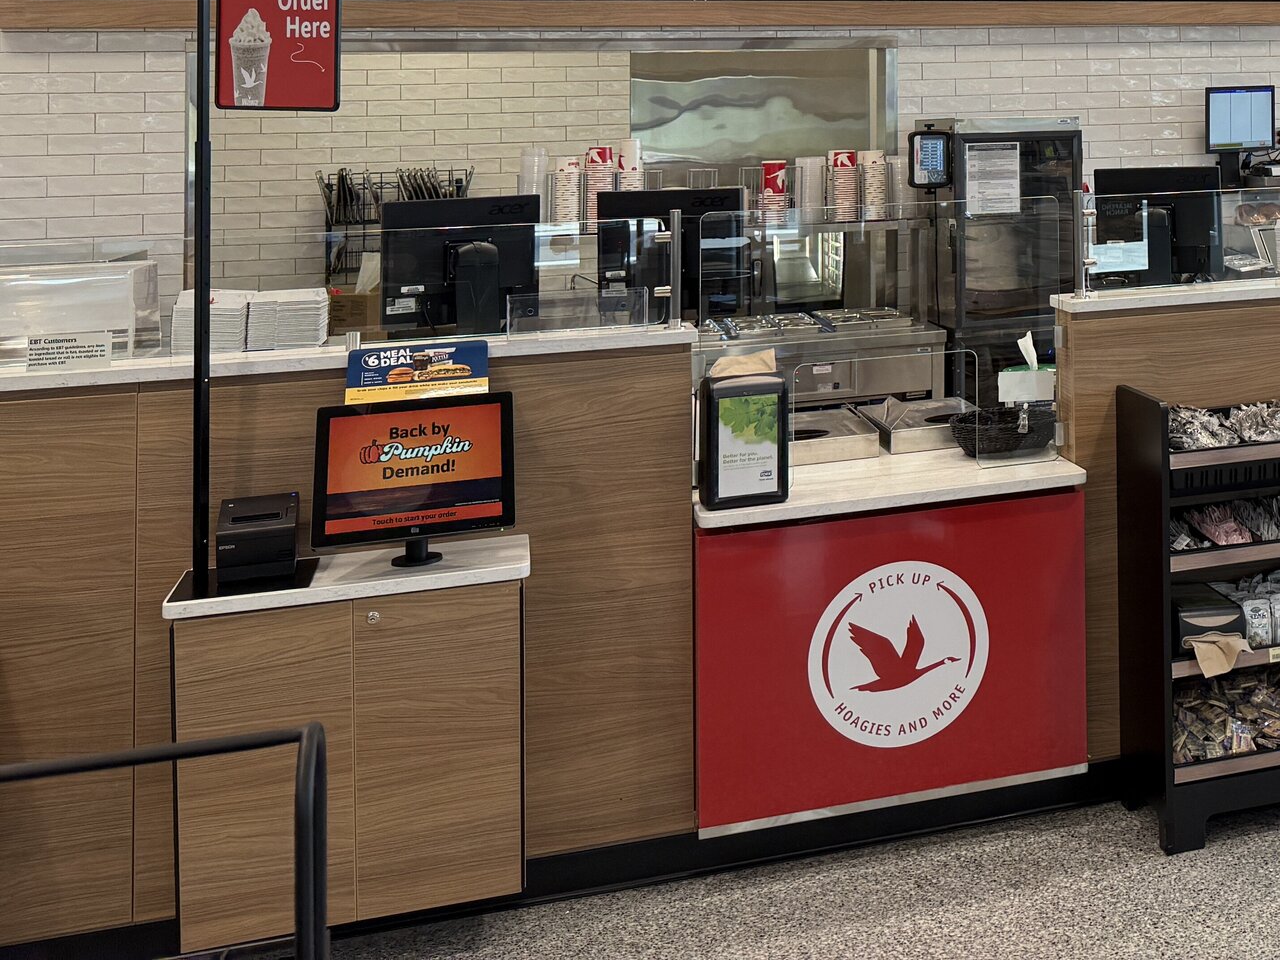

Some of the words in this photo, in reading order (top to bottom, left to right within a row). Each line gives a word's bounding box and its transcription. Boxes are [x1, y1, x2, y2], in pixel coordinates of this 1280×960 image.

[286, 16, 331, 38] Here
[488, 202, 530, 214] acer
[691, 195, 730, 208] acer
[380, 348, 413, 359] MEAL
[380, 356, 413, 367] DEAL
[389, 424, 427, 439] Back
[431, 422, 451, 437] by
[380, 436, 473, 463] Pumpkin
[382, 459, 455, 479] Demand!
[421, 513, 436, 521] your
[869, 573, 904, 593] PICK
[912, 573, 931, 585] UP
[834, 702, 891, 736] HOAGIES
[898, 717, 928, 736] AND
[932, 683, 966, 720] MORE
